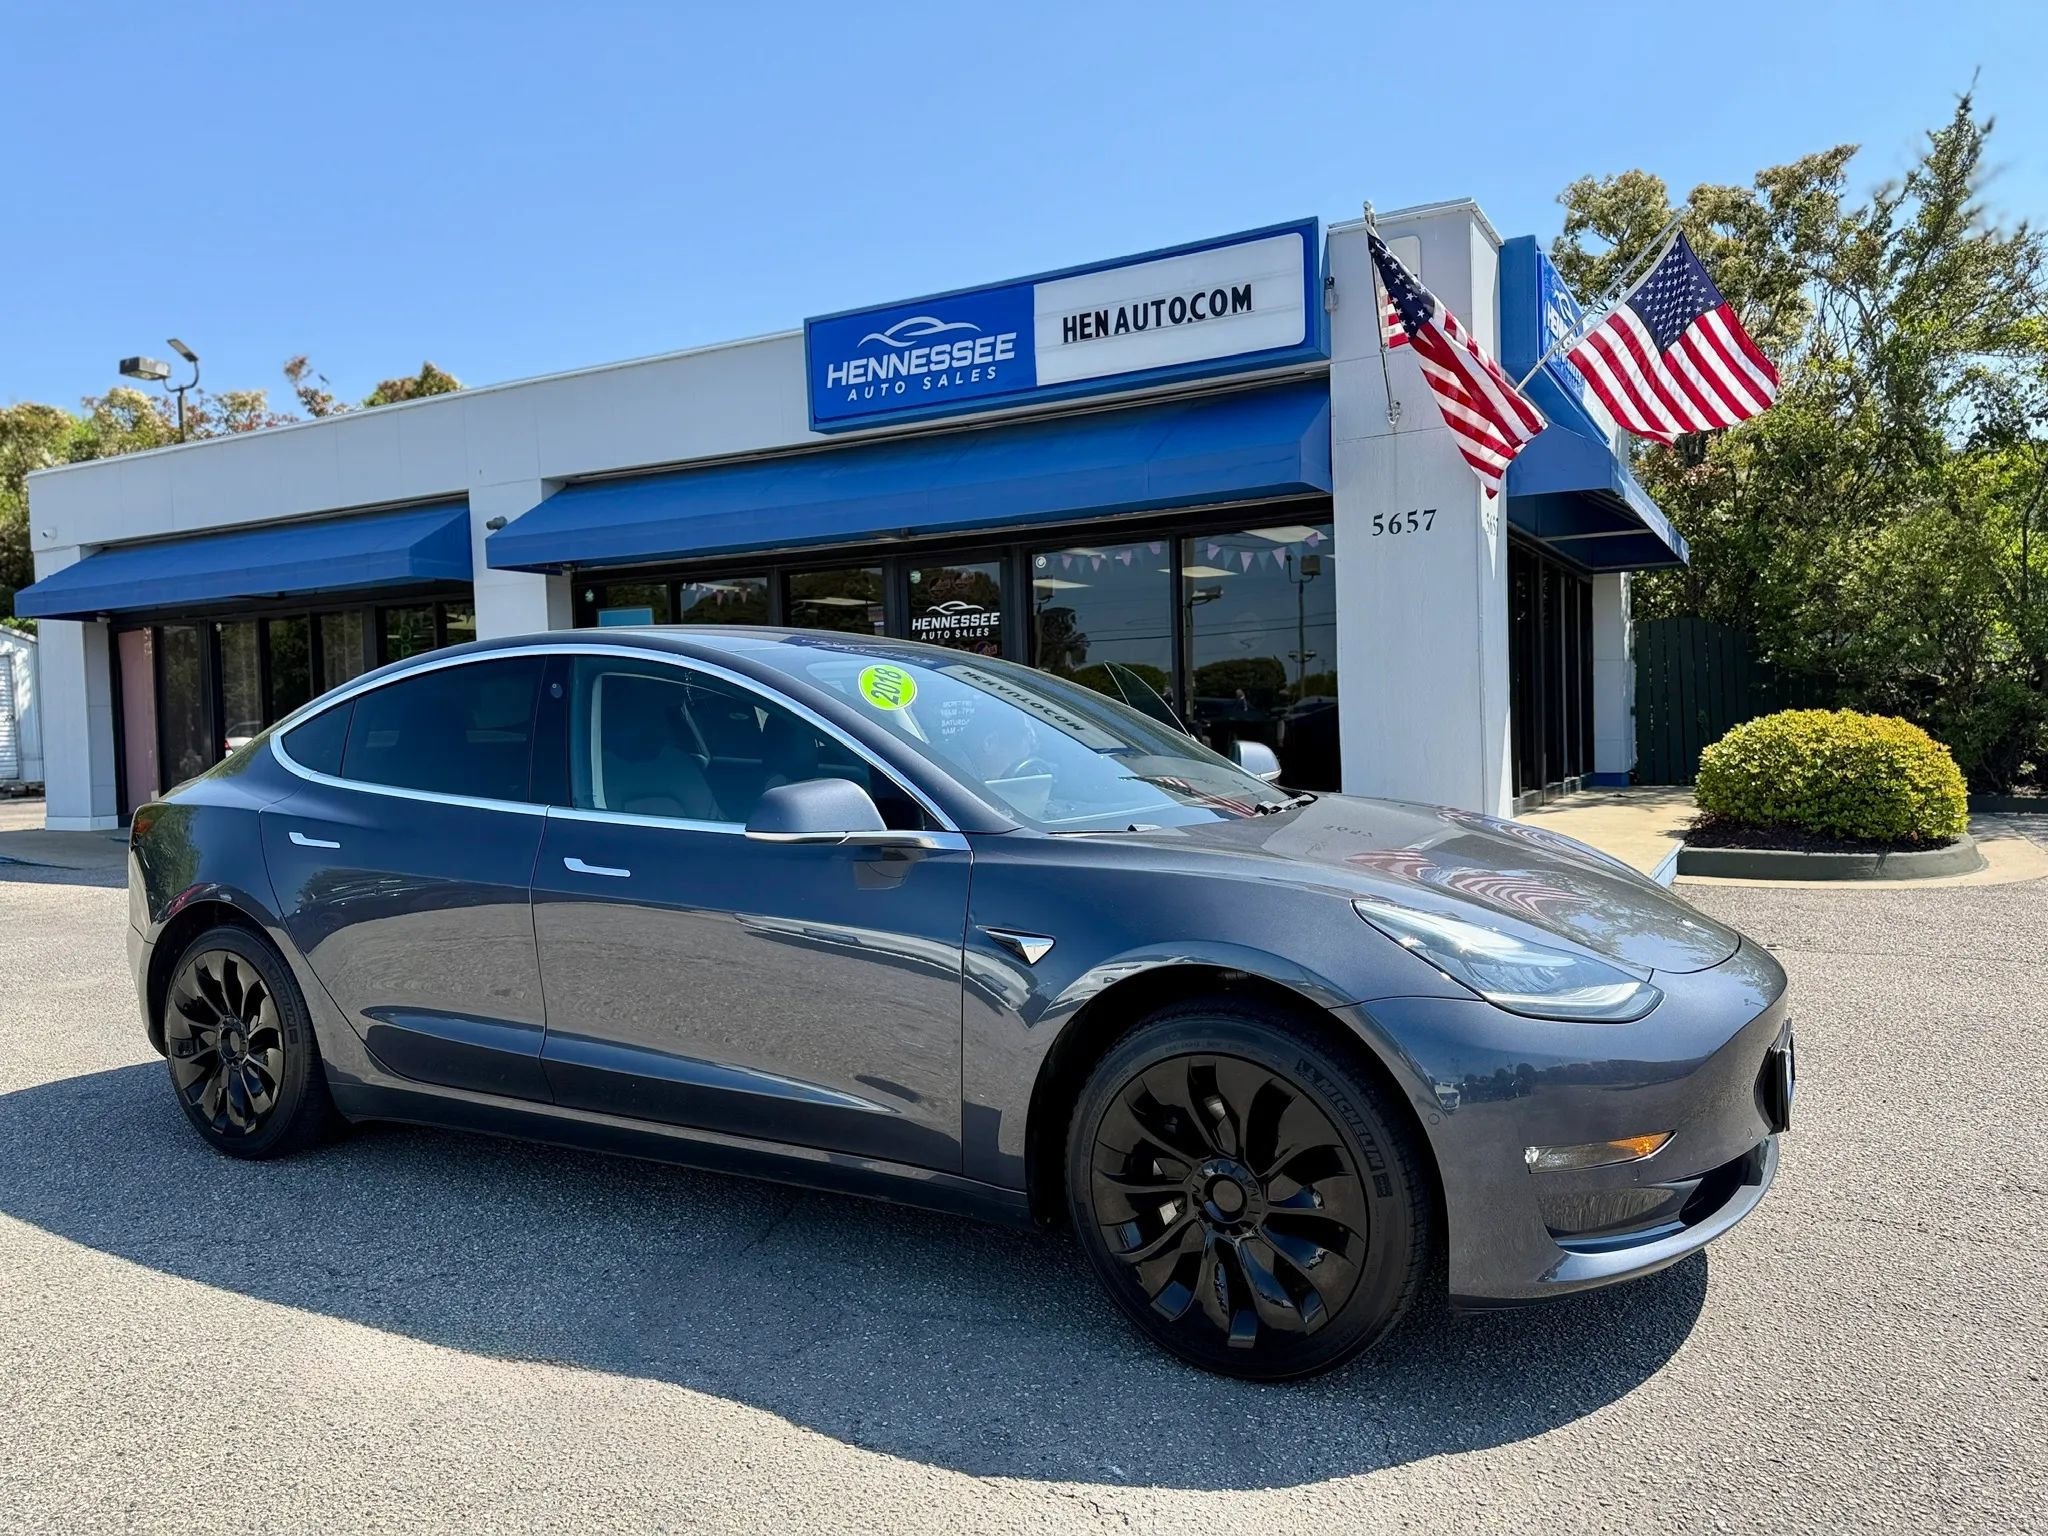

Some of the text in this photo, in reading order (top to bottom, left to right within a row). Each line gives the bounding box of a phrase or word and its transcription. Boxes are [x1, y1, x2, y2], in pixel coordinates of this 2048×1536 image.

[827, 332, 1017, 388] HENNESSEE
[847, 366, 997, 401] AUTO SALES
[1371, 508, 1437, 536] 5657
[911, 612, 1001, 631] HENNESSEE
[920, 627, 989, 640] AUTO SALES
[871, 667, 902, 705] 2018
[1314, 1079, 1386, 1171] MICHELIN
